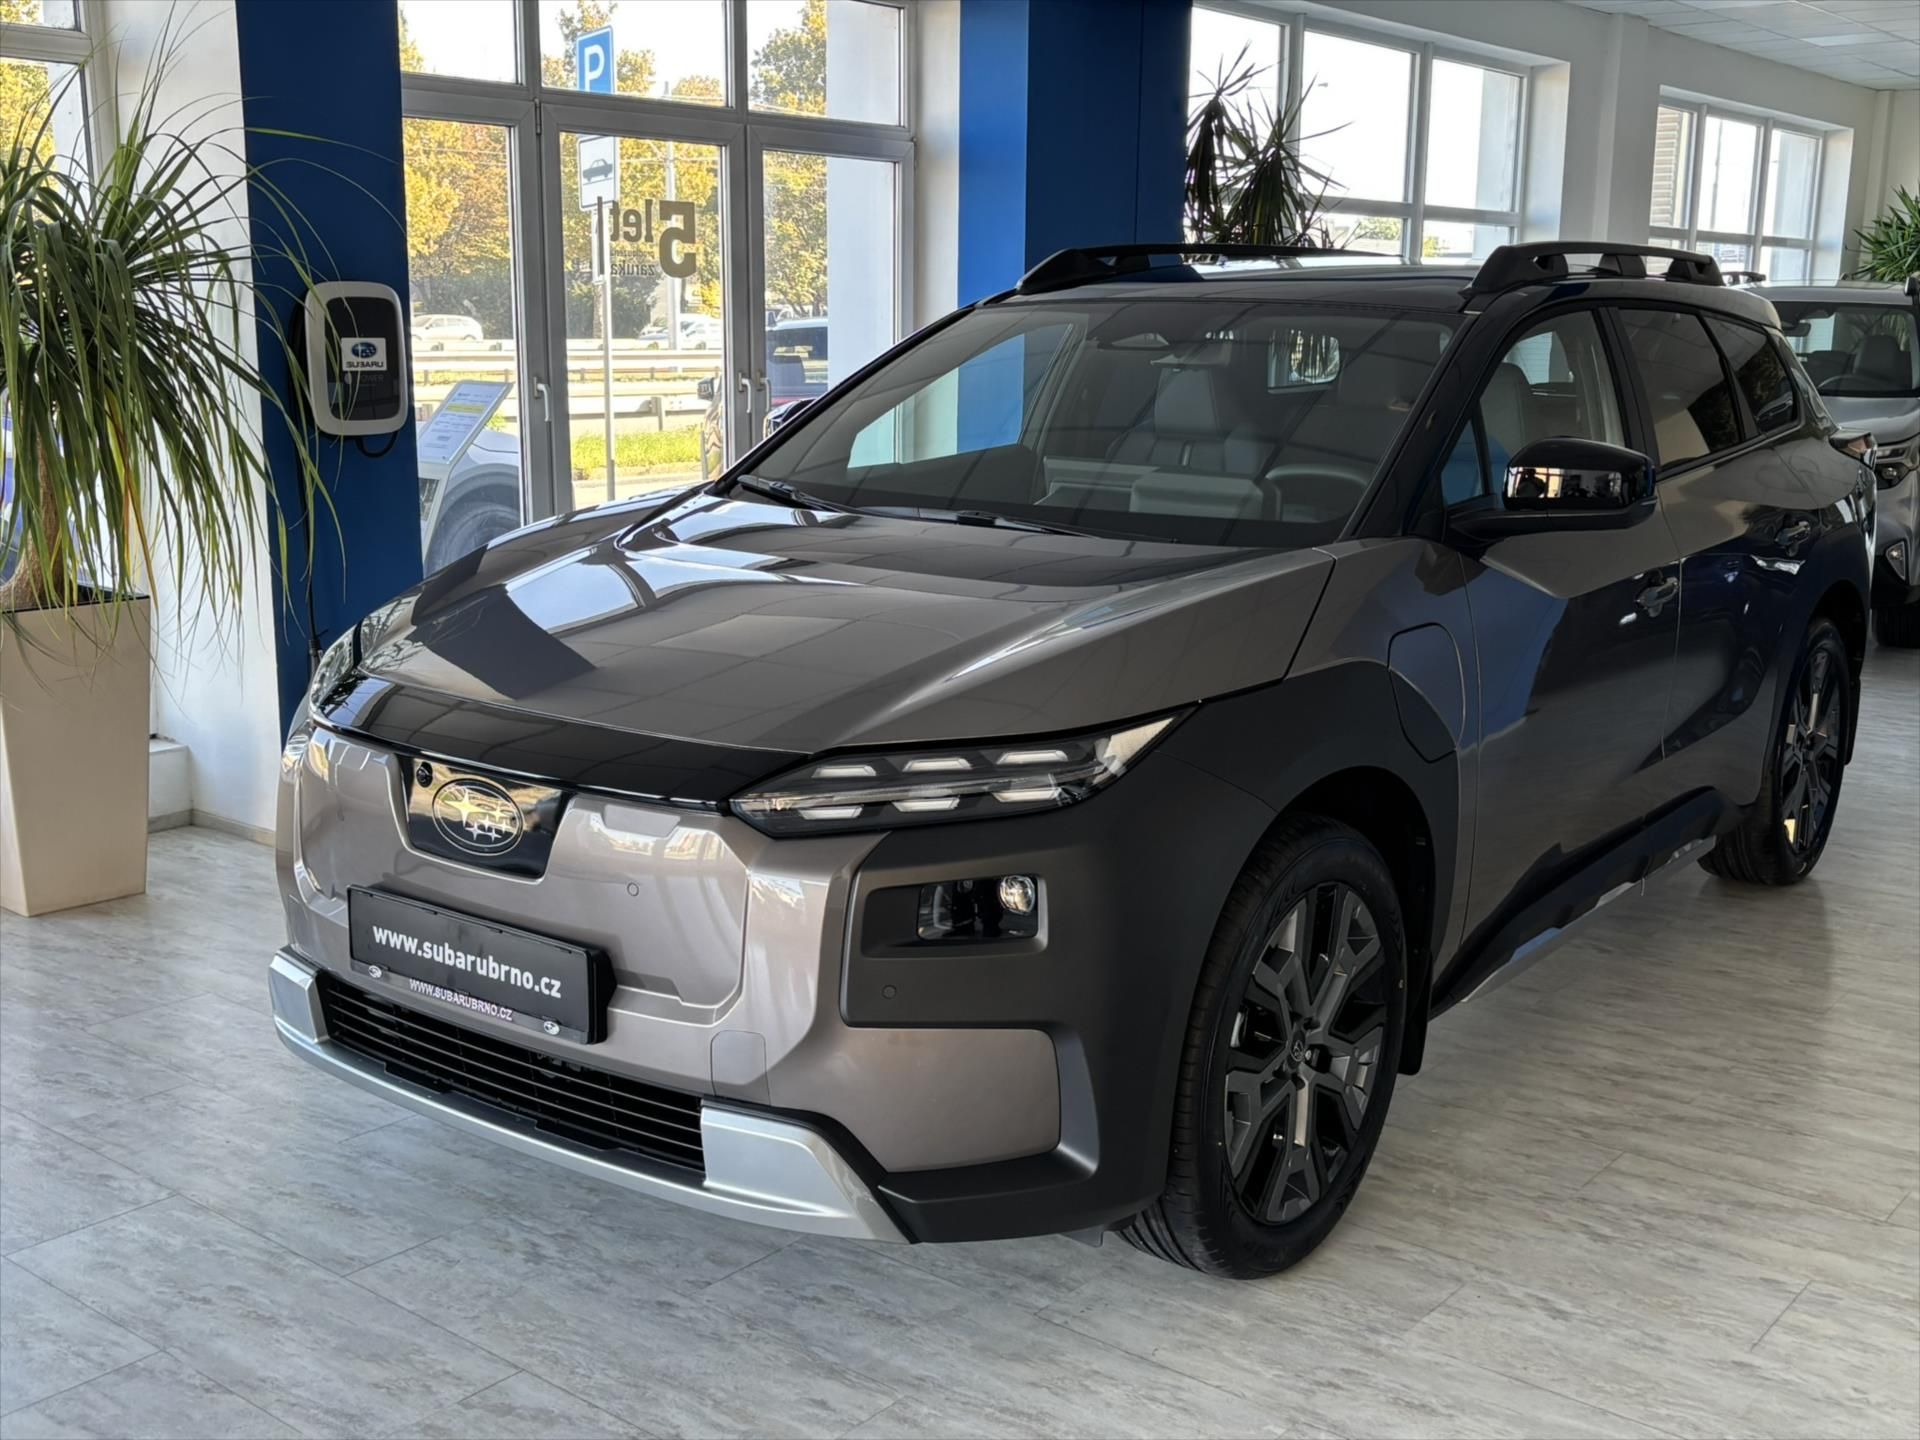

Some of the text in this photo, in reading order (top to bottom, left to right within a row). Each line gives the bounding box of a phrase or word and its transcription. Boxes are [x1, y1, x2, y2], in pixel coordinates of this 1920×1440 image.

[584, 44, 605, 92] P
[372, 926, 562, 998] www.subarubrno.cz
[409, 978, 513, 1021] WWW.SUBARUBRNO.CZ
